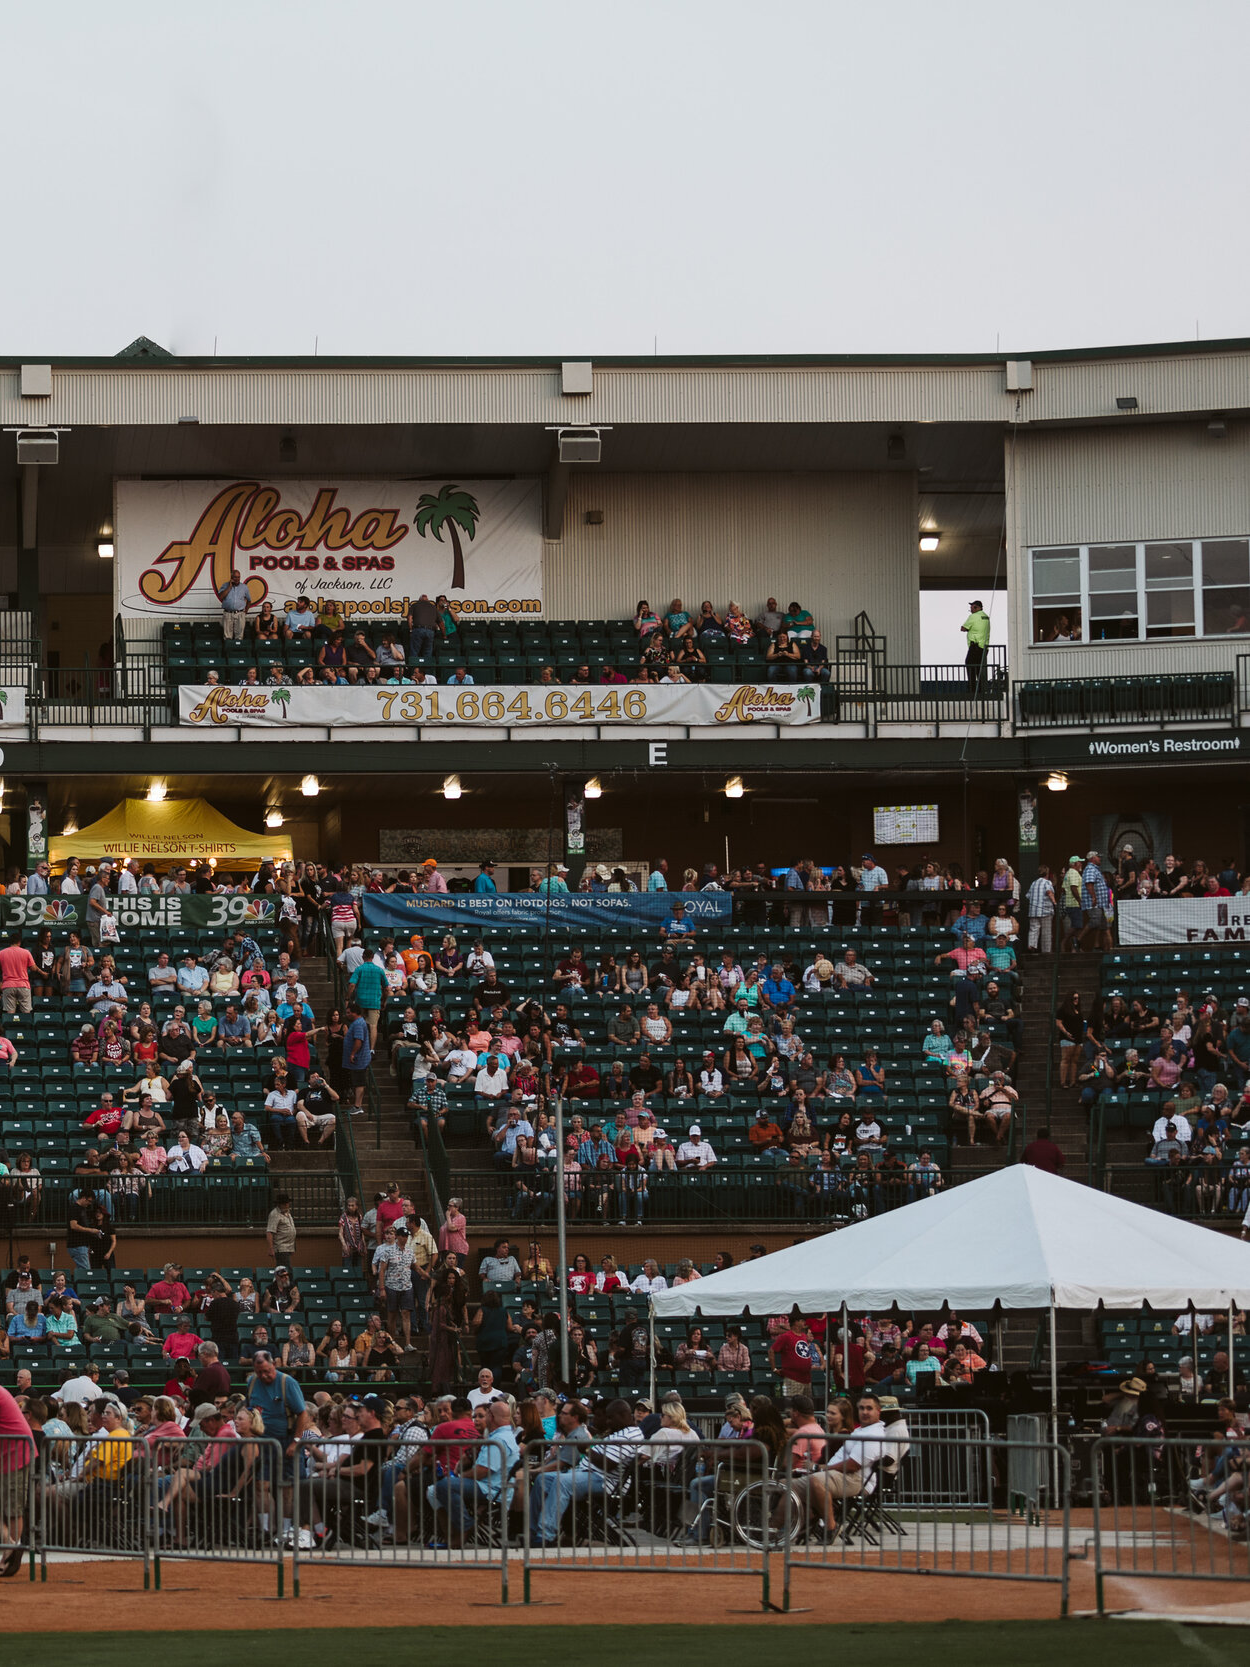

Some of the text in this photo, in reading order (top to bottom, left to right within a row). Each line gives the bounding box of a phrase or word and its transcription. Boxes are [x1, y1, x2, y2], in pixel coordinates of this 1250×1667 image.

[138, 481, 409, 607] Aloha
[249, 555, 395, 571] POOLS & SPAS
[295, 578, 393, 594] of Jackson, LLC
[283, 596, 542, 618] aohapoolsjson.com
[189, 686, 270, 723] Aloha
[376, 690, 647, 720] 731.664.6446
[714, 685, 796, 722] Aloha
[649, 742, 668, 765] E
[1094, 738, 1234, 754] Women's Restroom
[129, 832, 161, 840] WILLIE
[104, 843, 236, 853] WILLIE NELSON T-SHIRTS
[5, 896, 47, 926] 39
[160, 897, 182, 910] IS
[206, 896, 251, 926] 39
[406, 898, 632, 908] MUSTARD IS BEST ON HOTDOGS, NOT SOFAS.
[684, 900, 723, 913] OYAL
